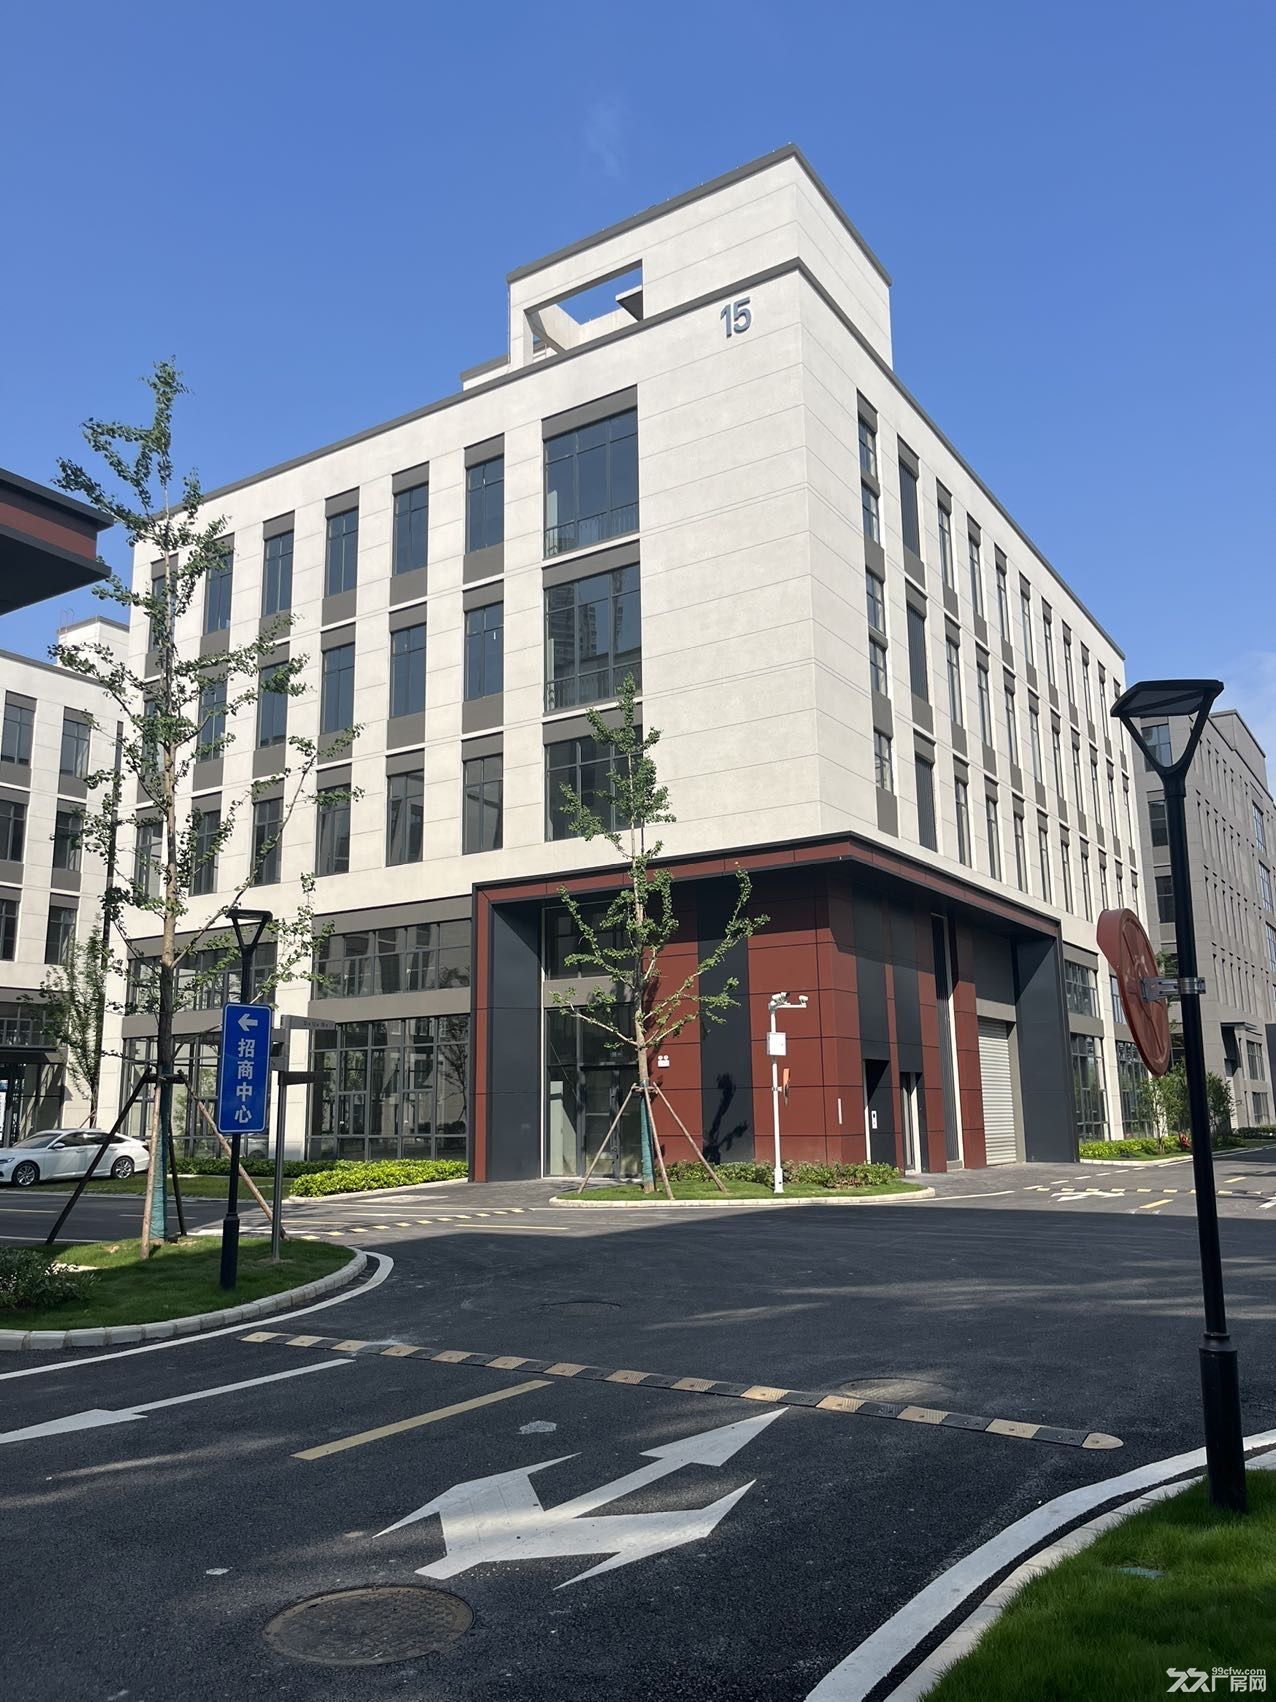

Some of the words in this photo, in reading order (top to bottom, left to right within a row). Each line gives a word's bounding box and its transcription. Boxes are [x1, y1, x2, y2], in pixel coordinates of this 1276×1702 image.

[720, 296, 752, 339] 15
[234, 1038, 256, 1124] 招商中心
